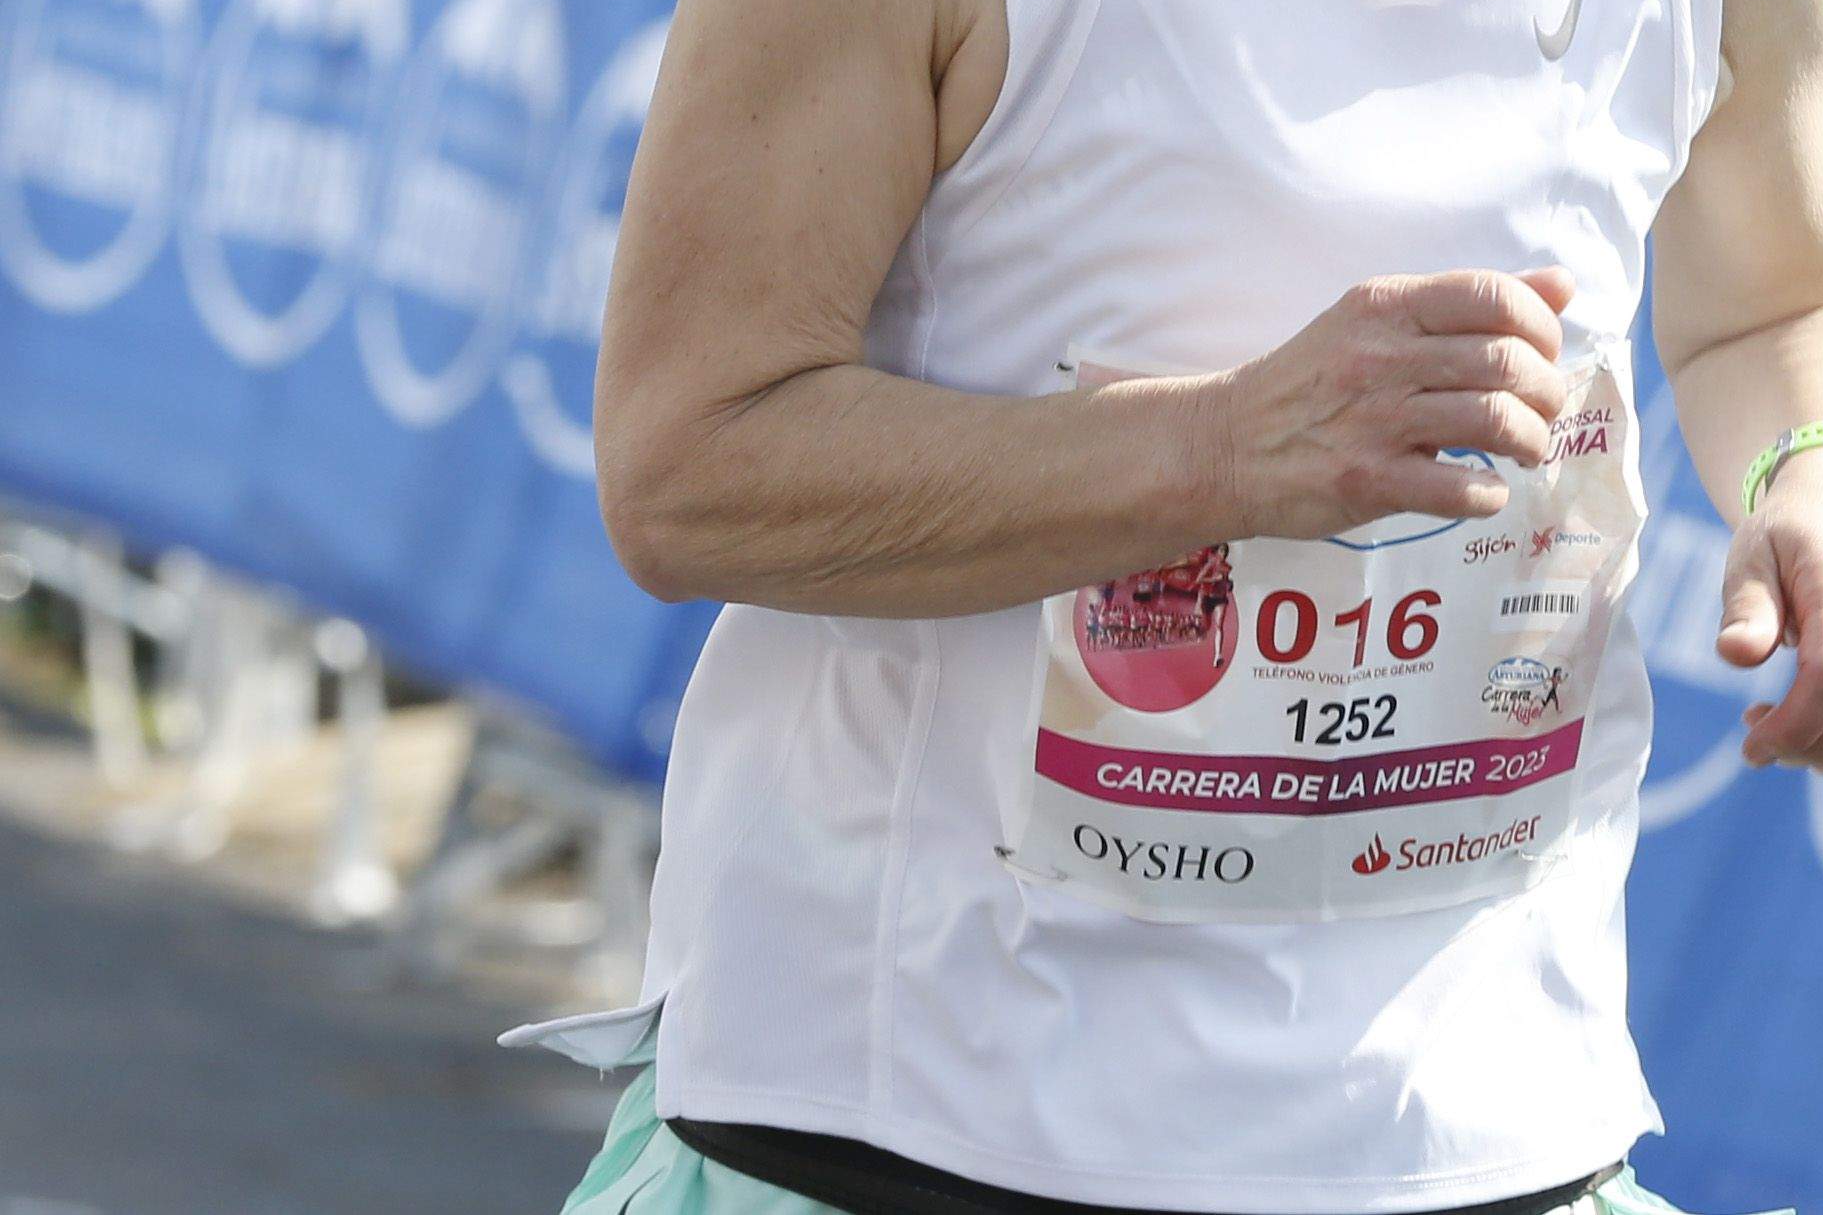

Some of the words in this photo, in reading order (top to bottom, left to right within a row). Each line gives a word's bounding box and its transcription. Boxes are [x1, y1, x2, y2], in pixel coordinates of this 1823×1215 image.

[1551, 408, 1614, 435] DORSAL
[1554, 532, 1601, 546] Deporte
[1256, 588, 1442, 668] 016
[1252, 665, 1315, 681] TELÉFONO
[1373, 666, 1387, 678] DE
[1390, 660, 1434, 676] GÉNERO
[1482, 685, 1531, 702] Carrera
[1507, 698, 1545, 726] Mujer
[1286, 693, 1398, 745] 1252
[1097, 762, 1261, 799] CARRERA
[1271, 772, 1324, 802] DE
[1328, 771, 1371, 801] LA
[1373, 757, 1475, 795] MUJER
[1485, 745, 1550, 782] 2023
[1073, 823, 1254, 883] OYSHO
[1396, 815, 1541, 870] Santander
